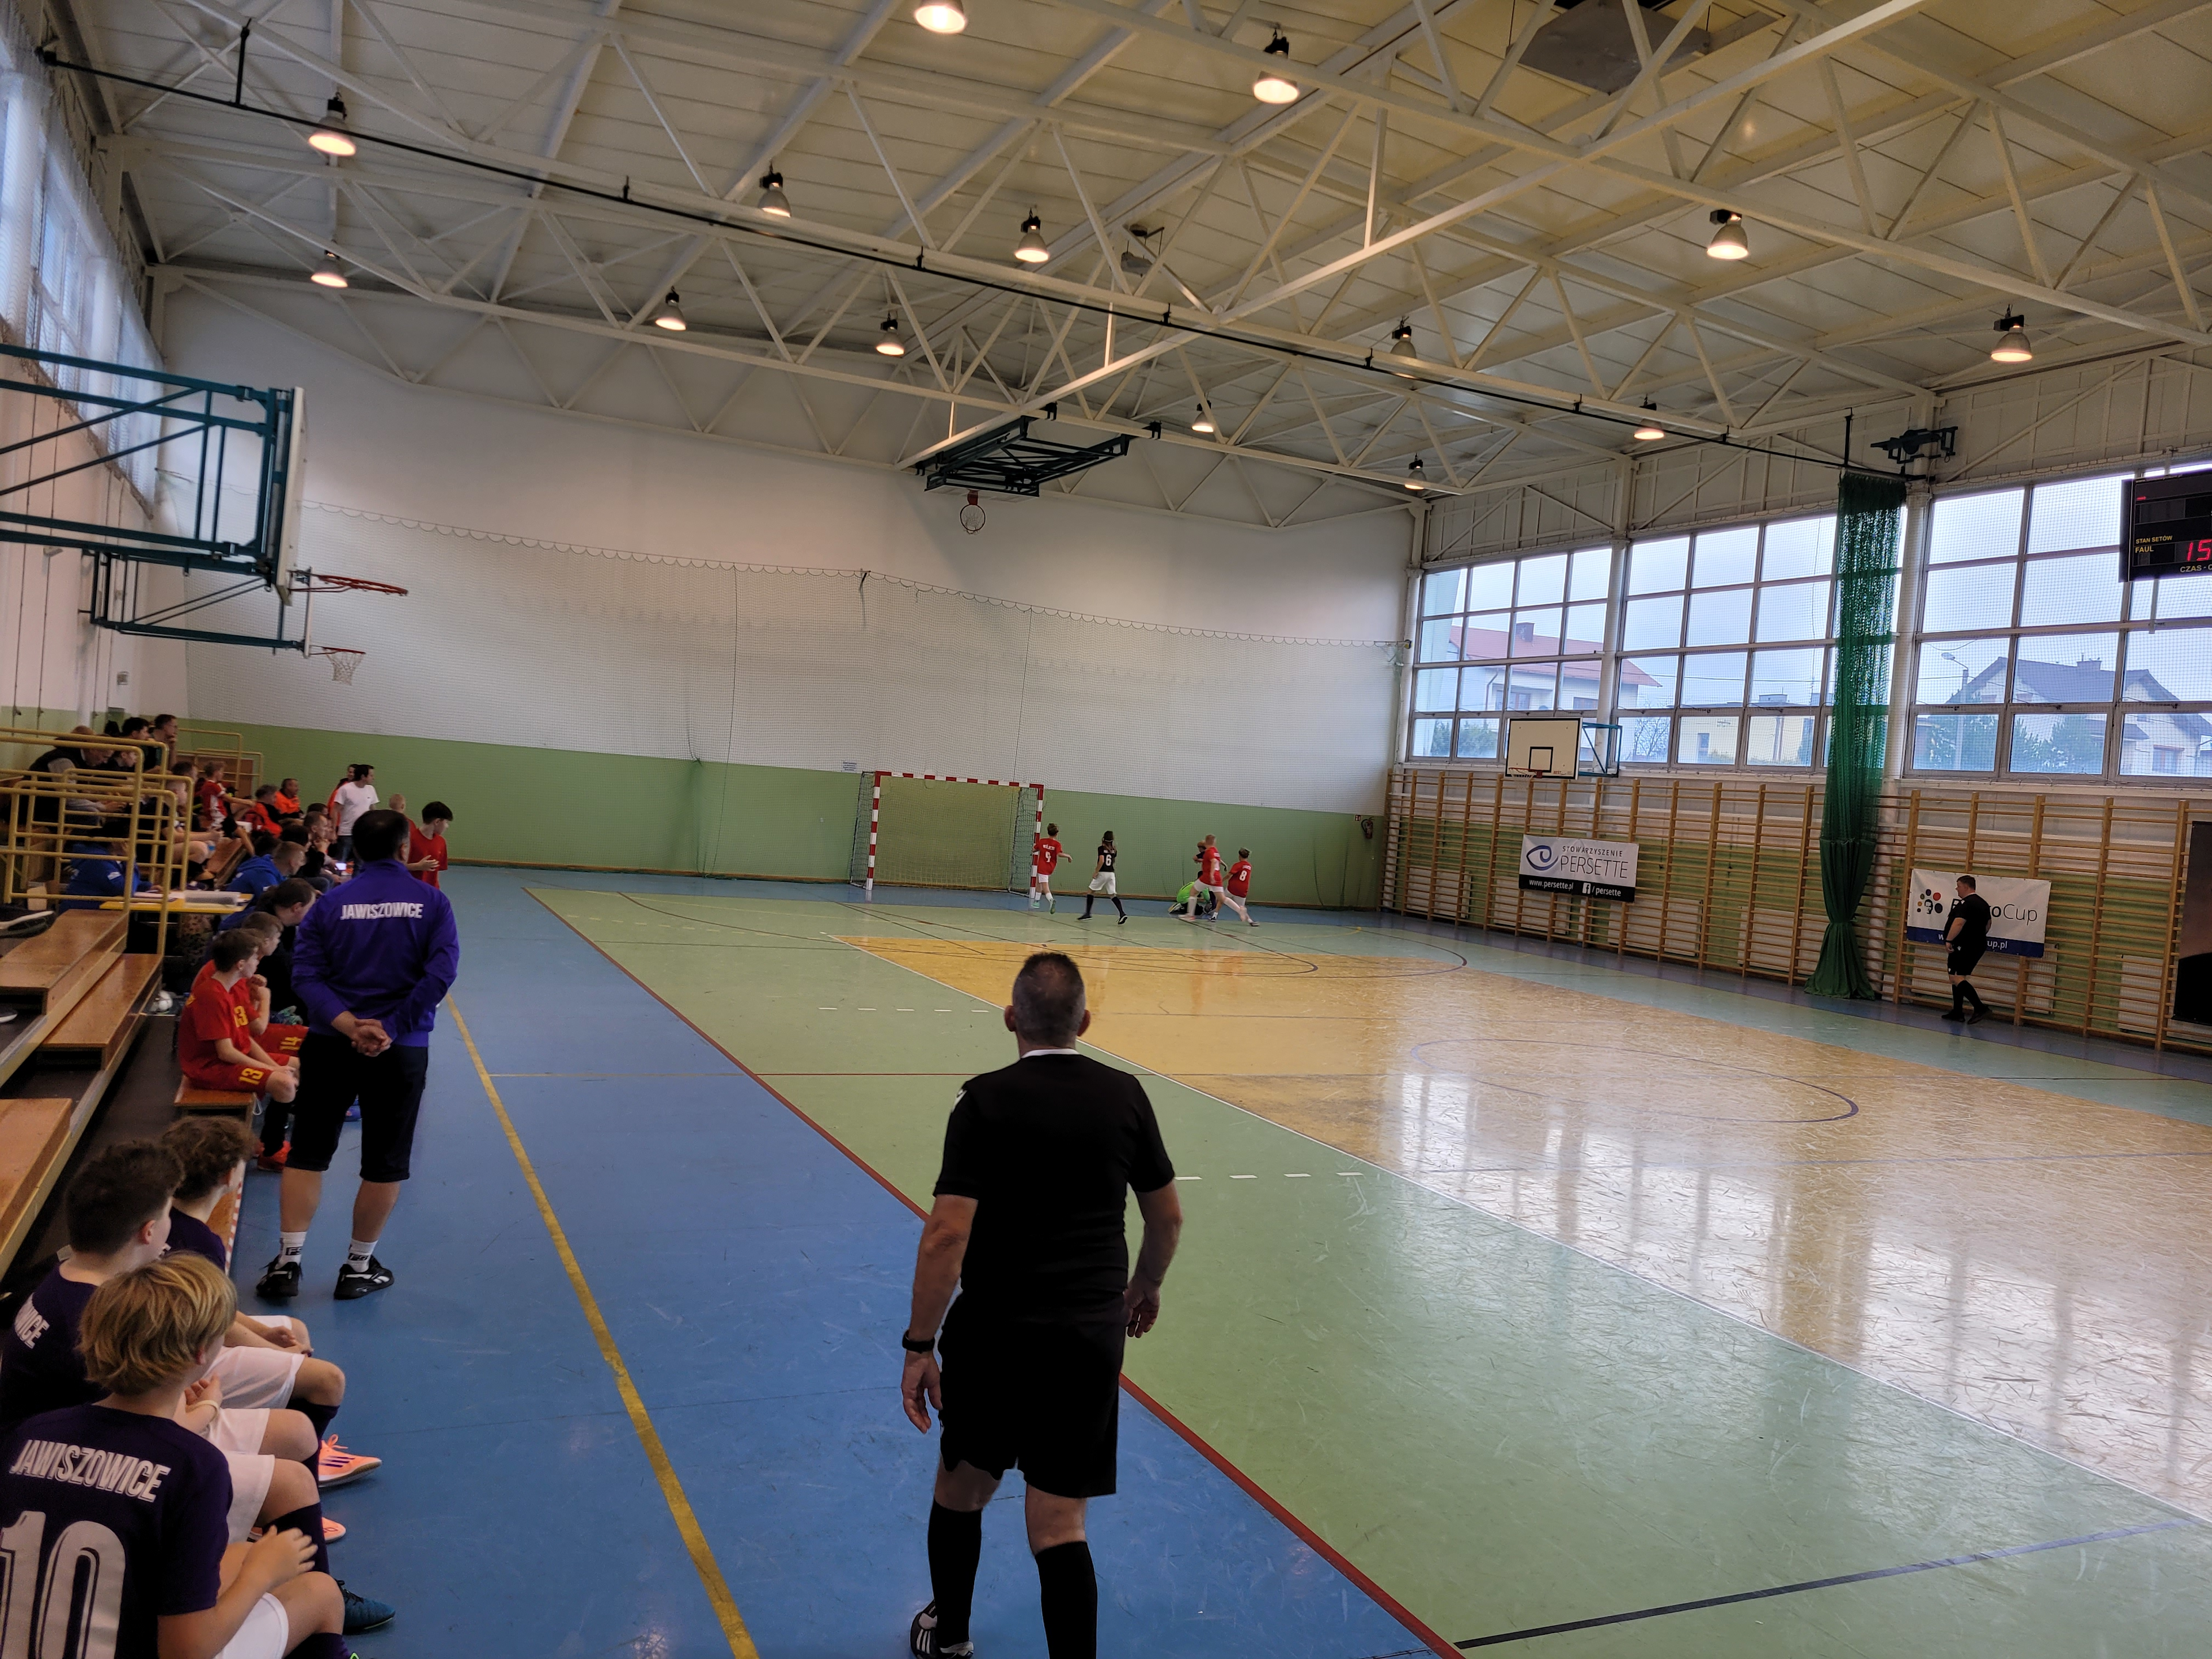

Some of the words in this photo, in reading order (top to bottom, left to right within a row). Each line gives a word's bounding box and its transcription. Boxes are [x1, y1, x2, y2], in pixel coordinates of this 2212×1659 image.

[2152, 535, 2173, 543] SETÓW
[2180, 565, 2202, 573] CZAS
[1562, 846, 1623, 857] STOWARZYSZENIE
[1105, 854, 1112, 866] 6
[1560, 855, 1629, 879] PERSETTE
[1239, 870, 1247, 881] 8
[1529, 879, 1574, 891] www.persette.pl
[1596, 888, 1622, 896] persette
[340, 902, 424, 921] JAWISZOWICE
[1990, 904, 2037, 926] oCup
[1987, 940, 2008, 950] up.pl
[279, 1036, 302, 1051] 14
[238, 1067, 264, 1085] 13
[9, 1439, 171, 1503] JAWISZOWICE
[0, 1510, 126, 1659] 10
